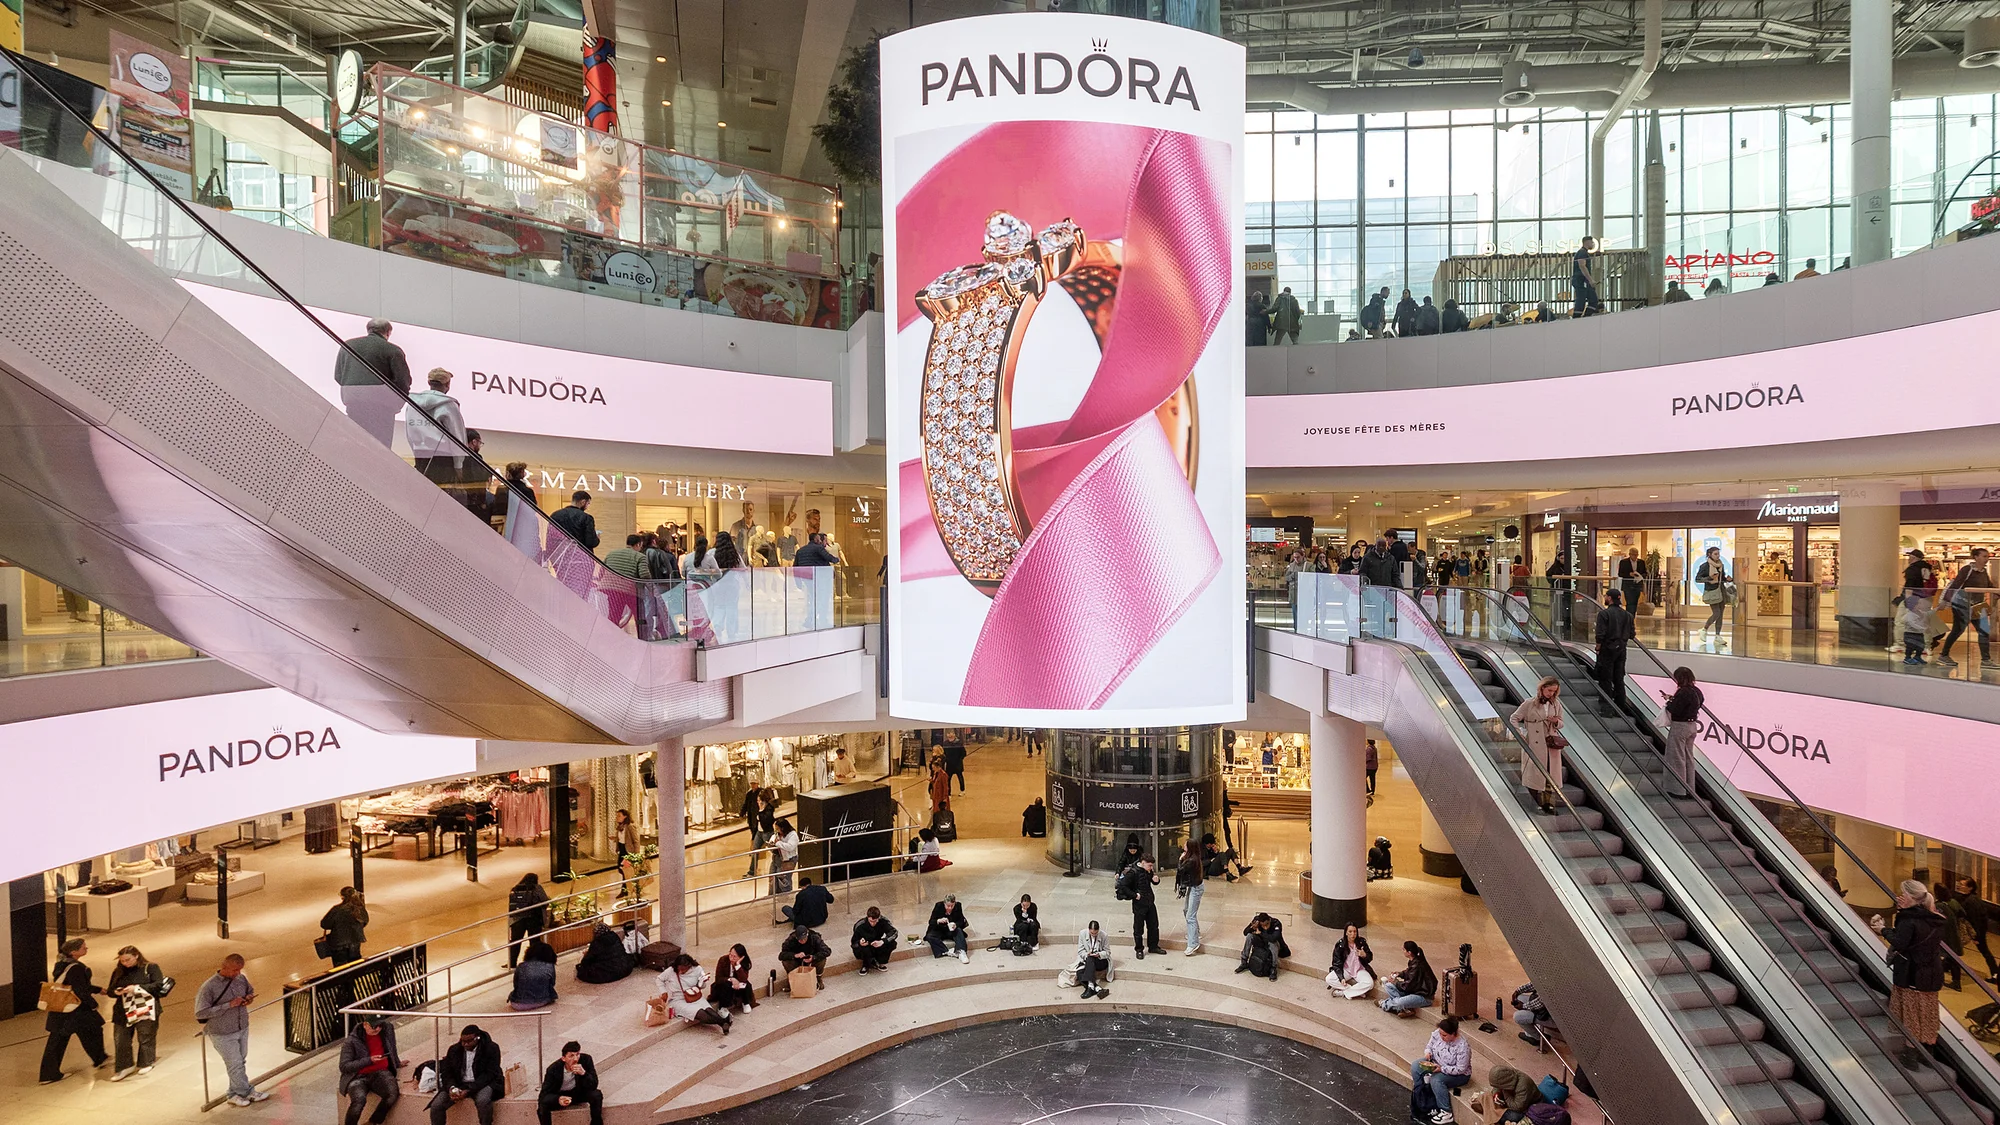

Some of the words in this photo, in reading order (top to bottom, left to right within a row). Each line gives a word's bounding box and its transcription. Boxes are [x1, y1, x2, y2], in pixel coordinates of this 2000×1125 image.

[921, 48, 1201, 112] PANDORA
[471, 371, 607, 405] PANDORA
[1672, 383, 1805, 416] PANDORA
[1304, 427, 1351, 435] JOYEUSE
[1354, 424, 1380, 434] FÊTE
[1385, 425, 1405, 433] DES
[1409, 422, 1446, 432] MÈRES
[658, 479, 747, 500] THIERY
[1757, 501, 1838, 520] Marionnaud
[159, 726, 341, 782] PANDORA
[1099, 801, 1116, 809] PLACE
[1124, 801, 1140, 810] DÔME
[829, 809, 873, 843] Harcourt
